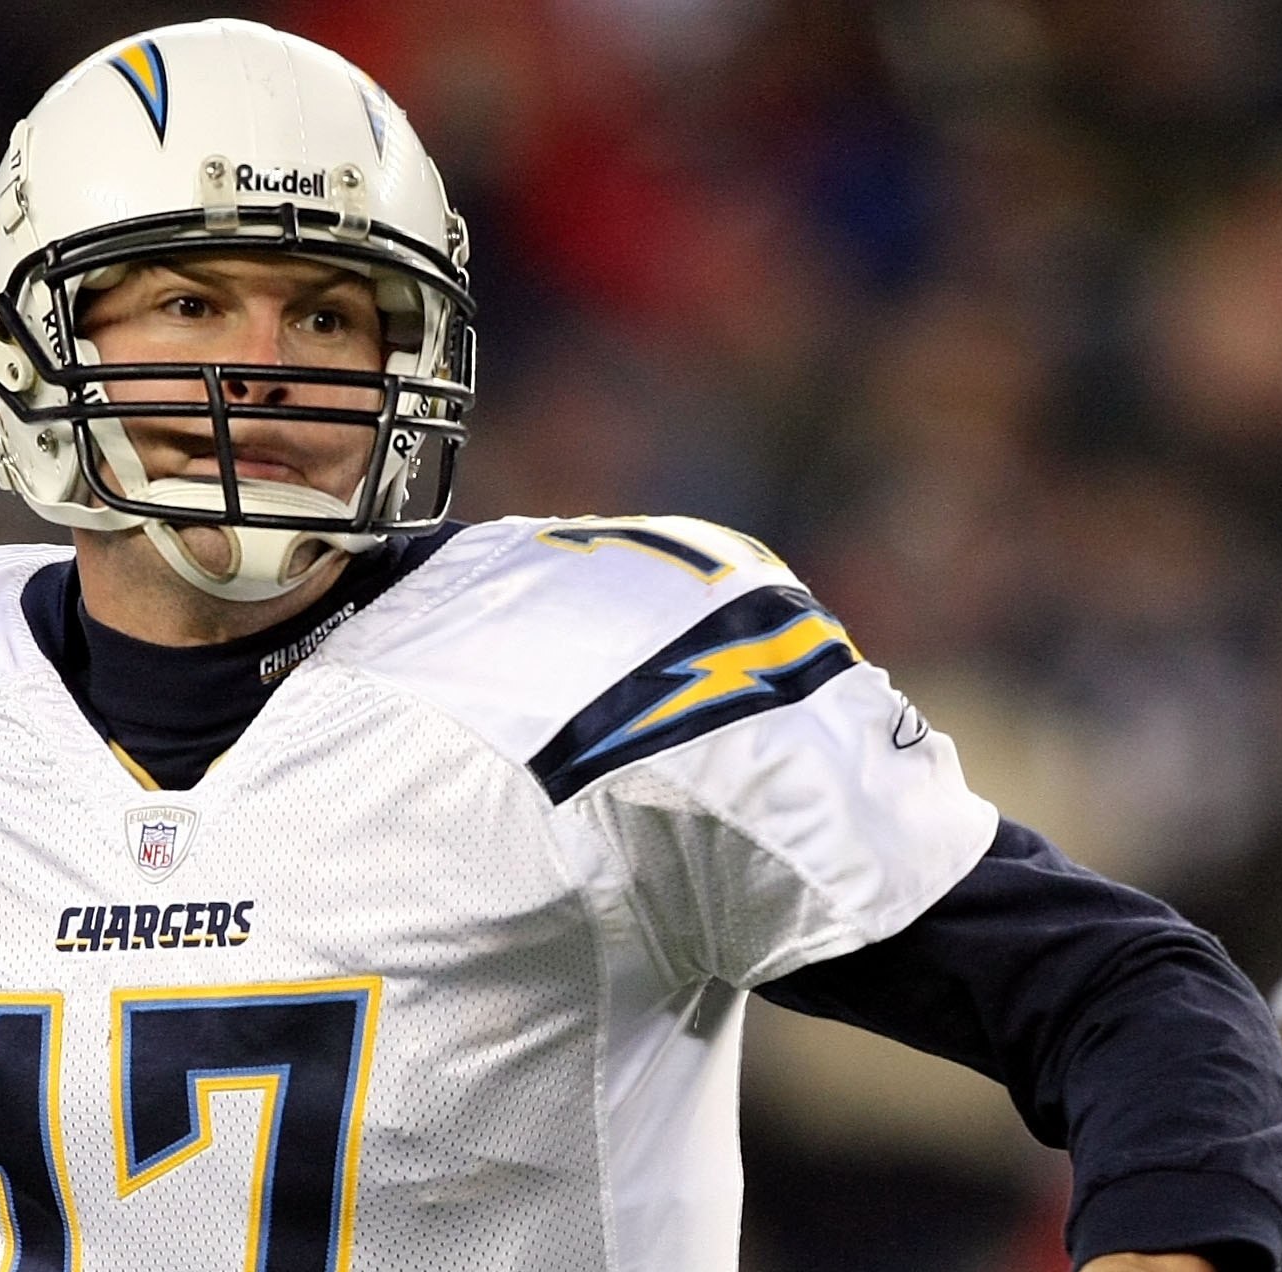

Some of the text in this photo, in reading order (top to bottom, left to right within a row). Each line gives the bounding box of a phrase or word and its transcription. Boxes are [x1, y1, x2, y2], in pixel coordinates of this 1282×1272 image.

[235, 163, 326, 199] Riddell
[141, 842, 171, 867] NFL
[54, 900, 255, 953] CHARGERS
